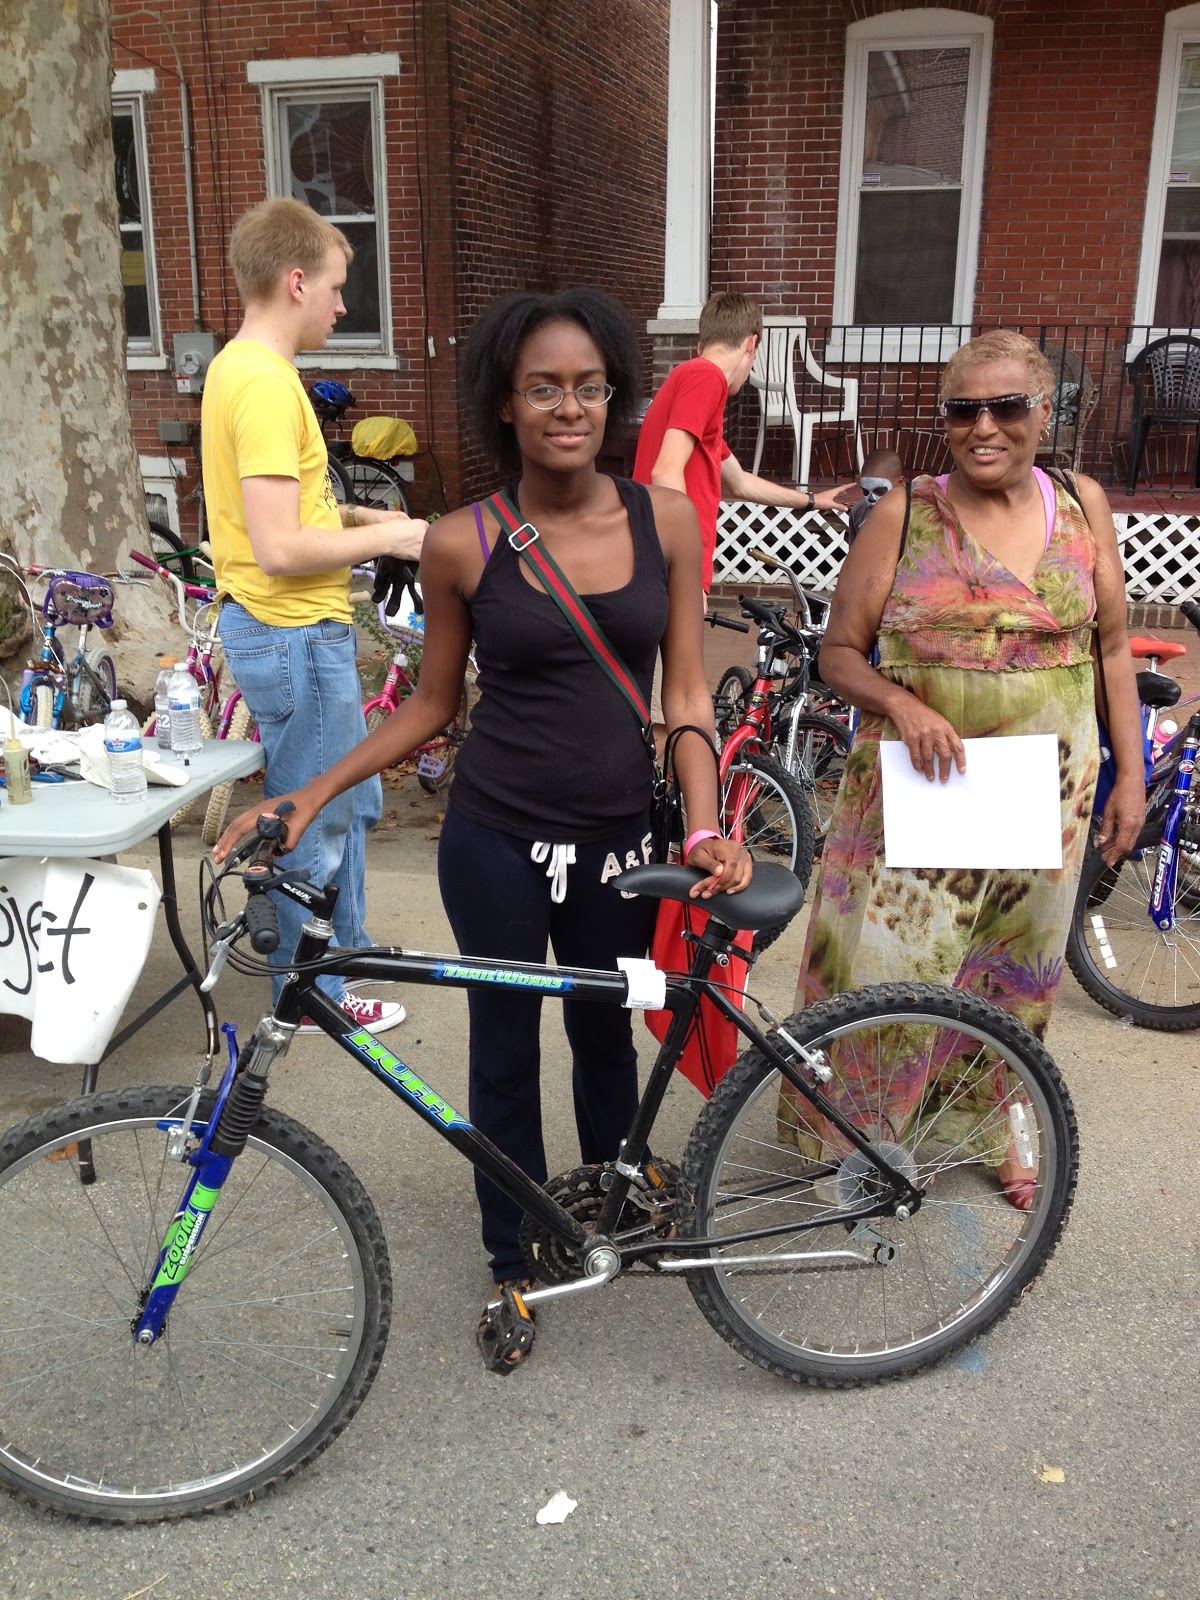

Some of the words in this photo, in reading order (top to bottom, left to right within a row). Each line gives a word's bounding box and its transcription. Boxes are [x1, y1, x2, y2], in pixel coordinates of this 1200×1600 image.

[342, 1028, 469, 1127] HUFFY
[161, 1207, 198, 1280] ZOOM
[179, 1211, 206, 1267] SUSPENSION
